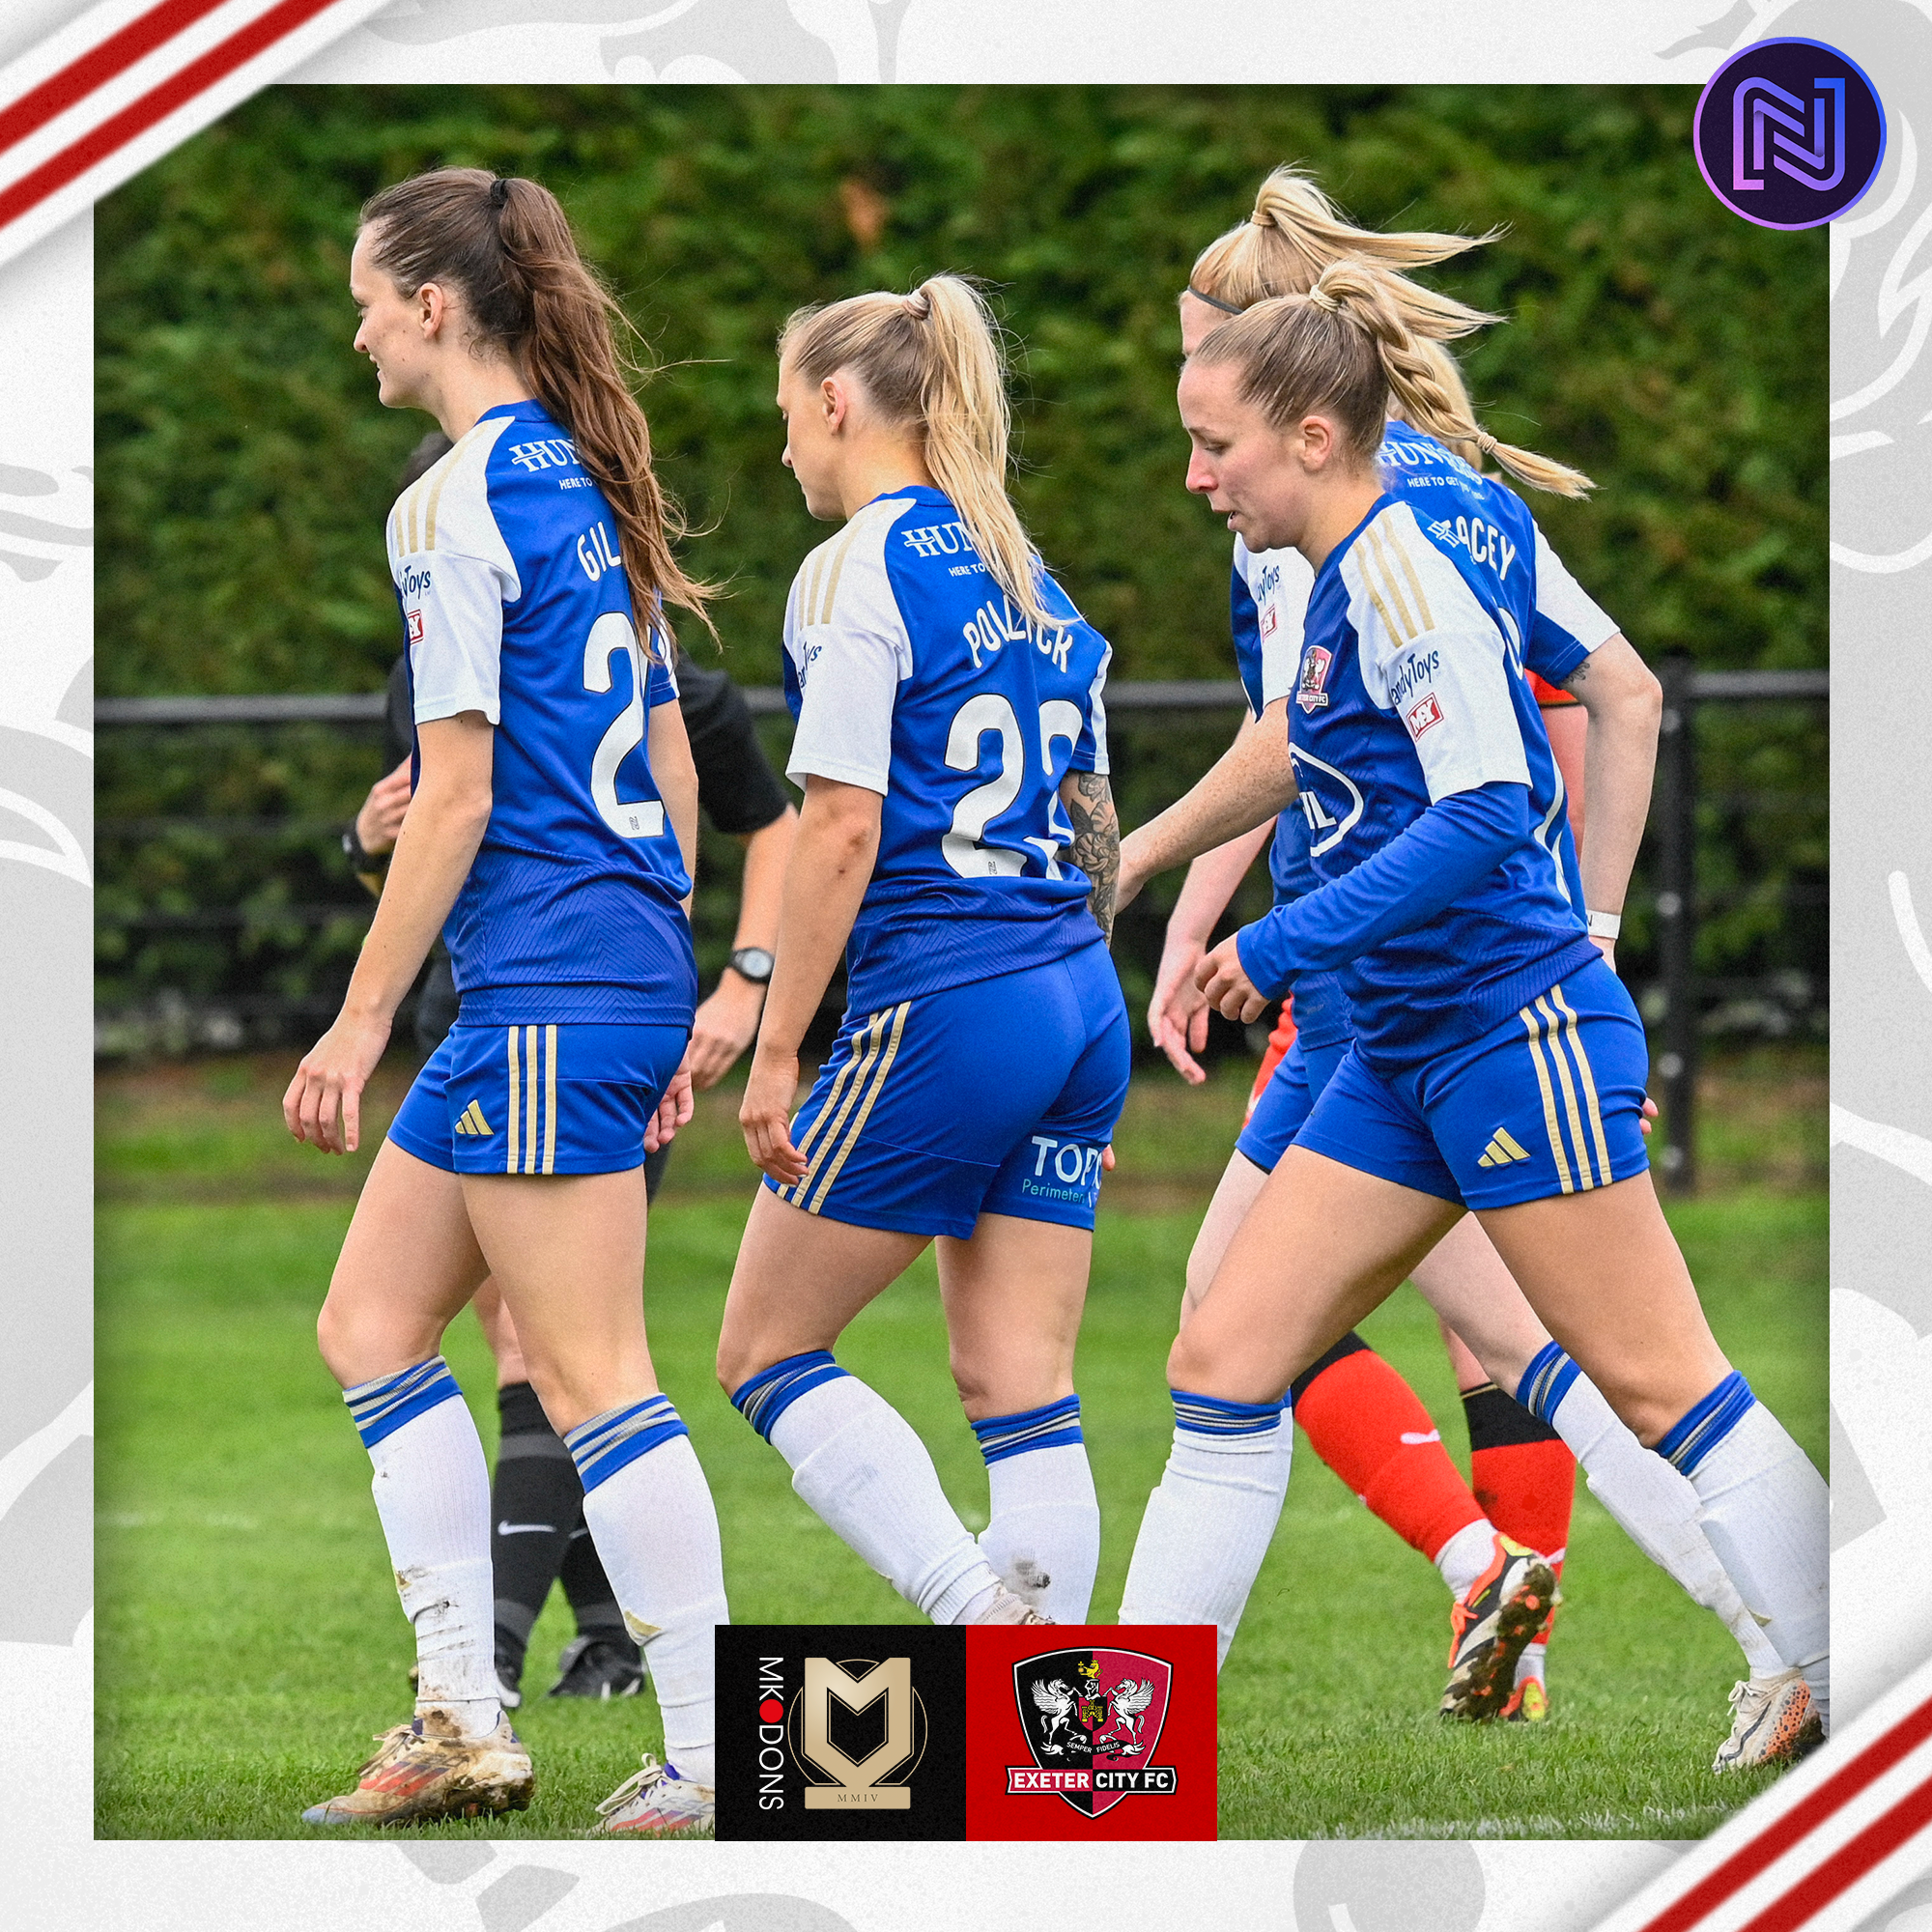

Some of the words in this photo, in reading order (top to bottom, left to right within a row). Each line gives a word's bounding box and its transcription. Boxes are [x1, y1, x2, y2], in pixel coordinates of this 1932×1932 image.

[559, 478, 582, 490] HERE
[582, 477, 593, 487] TO
[1407, 477, 1431, 488] HERE
[1431, 476, 1445, 487] TO
[949, 566, 972, 577] HERE
[971, 562, 986, 573] TO
